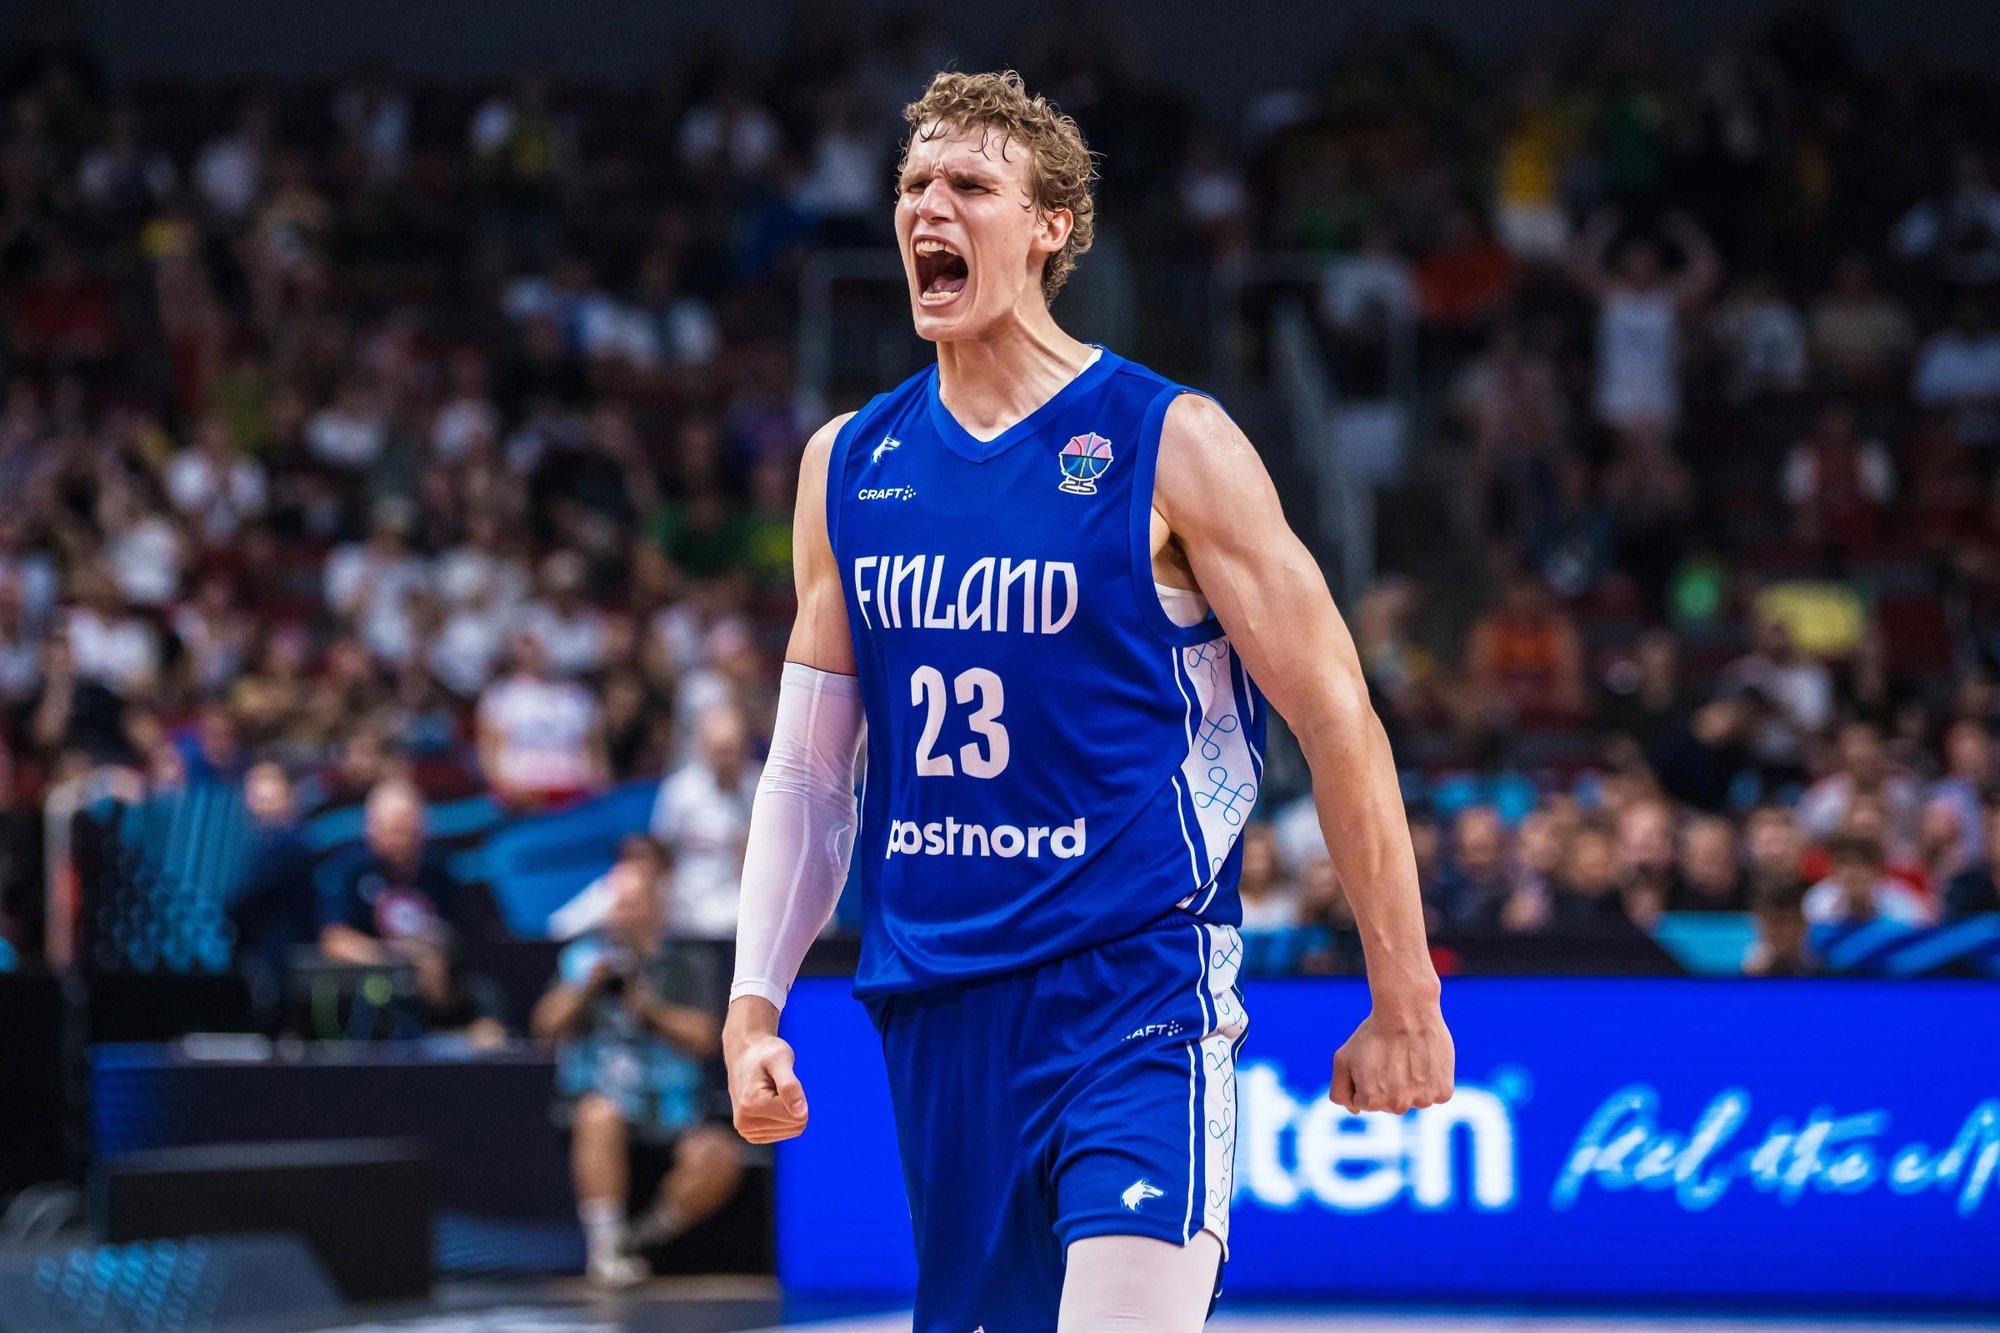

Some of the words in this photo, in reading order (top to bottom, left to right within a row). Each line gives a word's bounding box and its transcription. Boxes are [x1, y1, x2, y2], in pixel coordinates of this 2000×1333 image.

[857, 486, 904, 501] CRAFT
[854, 554, 1079, 635] FINLAND
[910, 664, 1010, 780] 23
[885, 816, 1086, 860] postnord
[1120, 1023, 1168, 1042] AFT
[1233, 1062, 1516, 1208] ten
